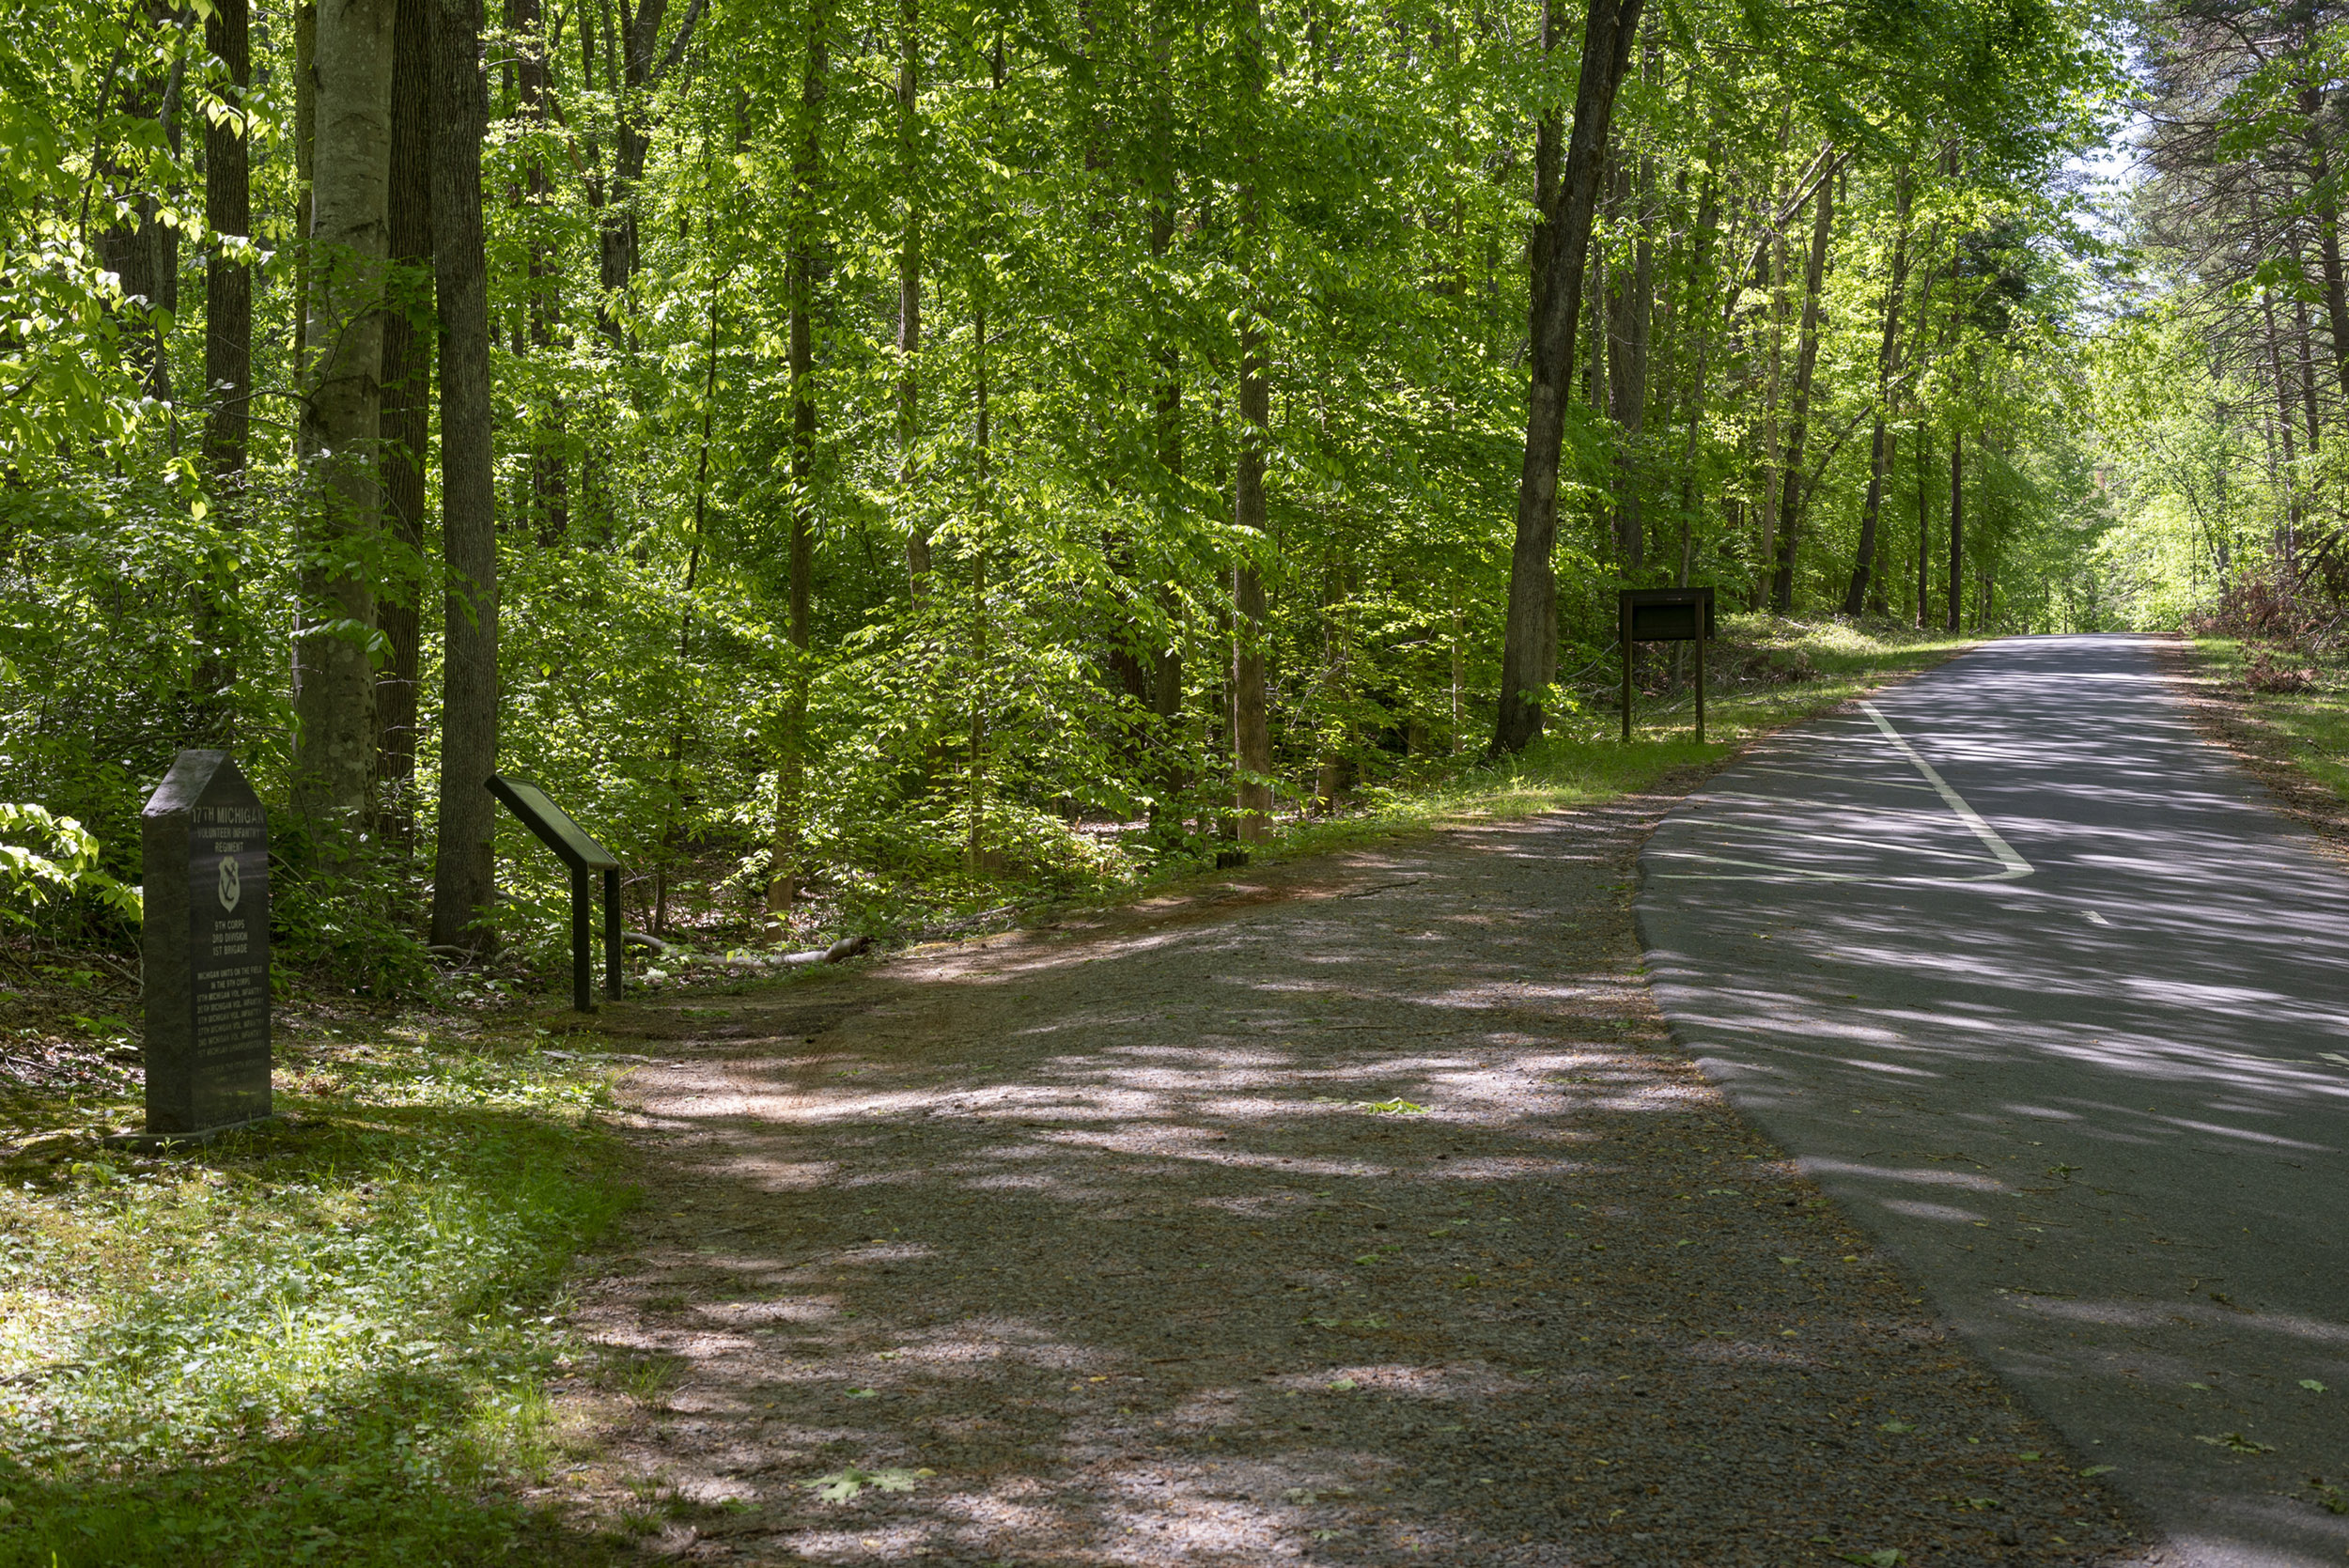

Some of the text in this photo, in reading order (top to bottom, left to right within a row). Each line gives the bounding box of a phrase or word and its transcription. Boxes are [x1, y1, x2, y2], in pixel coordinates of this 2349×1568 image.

[193, 806, 264, 824] 17TH MICHIGAN
[197, 827, 261, 839] VOLUNTEER INFANTRY
[215, 842, 243, 853] REGIMENT
[214, 919, 245, 931] 9TH CORPS
[212, 932, 248, 943] 3RD DIVISION
[212, 943, 248, 956] 1ST BRIGADE
[197, 965, 262, 981] MICHIGAN UNITS ON THE FIELD
[210, 982, 216, 990] IN
[217, 980, 226, 989] THE
[236, 977, 251, 986] CORPS
[209, 991, 230, 1001] MICHIGAN
[241, 986, 263, 997] INFANTRY
[210, 1001, 232, 1012] MICHIGAN
